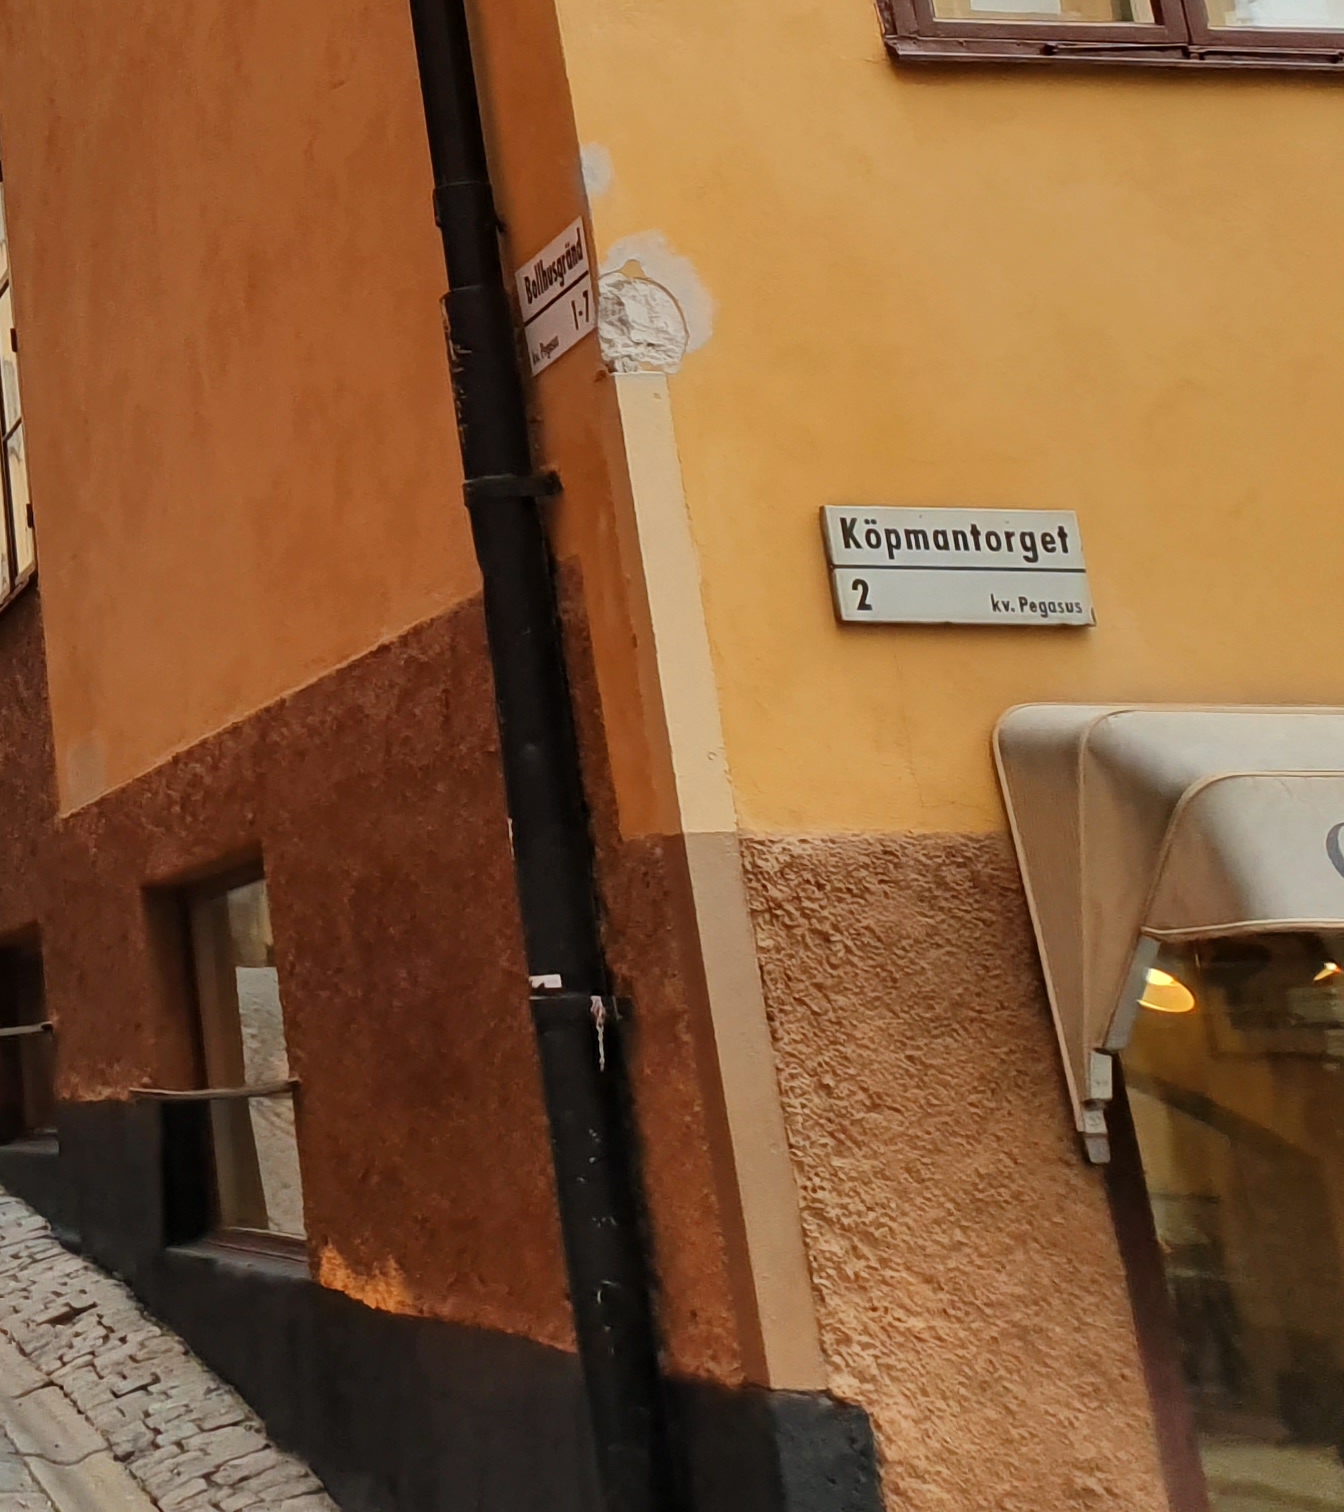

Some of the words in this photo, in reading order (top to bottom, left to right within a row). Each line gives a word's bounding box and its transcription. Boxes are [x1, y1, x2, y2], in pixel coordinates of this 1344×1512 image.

[524, 227, 584, 305] Bollhusgränd
[839, 517, 1069, 563] Köpmantorget
[851, 578, 873, 611] 2
[990, 593, 1016, 614] kv.
[1018, 596, 1083, 618] Pegasus
